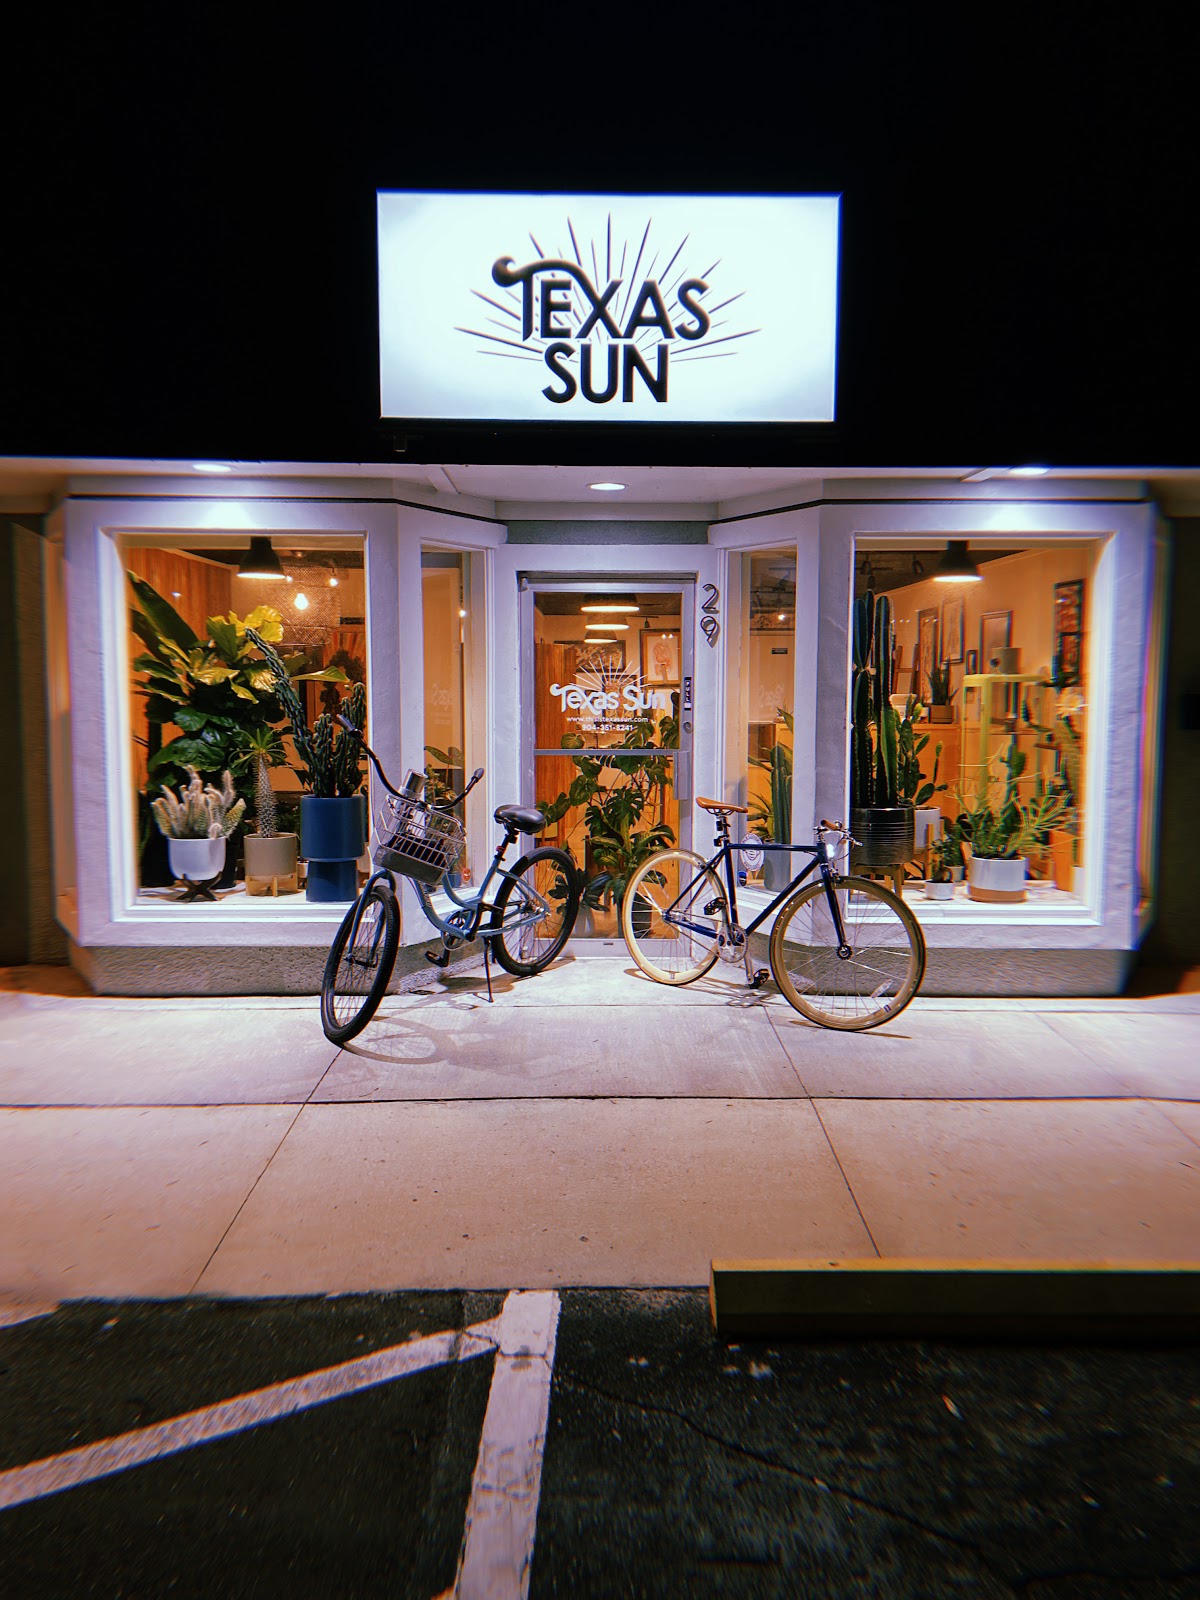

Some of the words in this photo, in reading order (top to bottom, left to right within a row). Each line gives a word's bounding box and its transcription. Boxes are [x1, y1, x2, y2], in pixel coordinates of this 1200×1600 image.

[491, 255, 711, 341] TEXAS
[541, 341, 670, 404] SUN
[700, 583, 718, 643] 29
[550, 683, 621, 715] Texas
[622, 685, 666, 711] Sun
